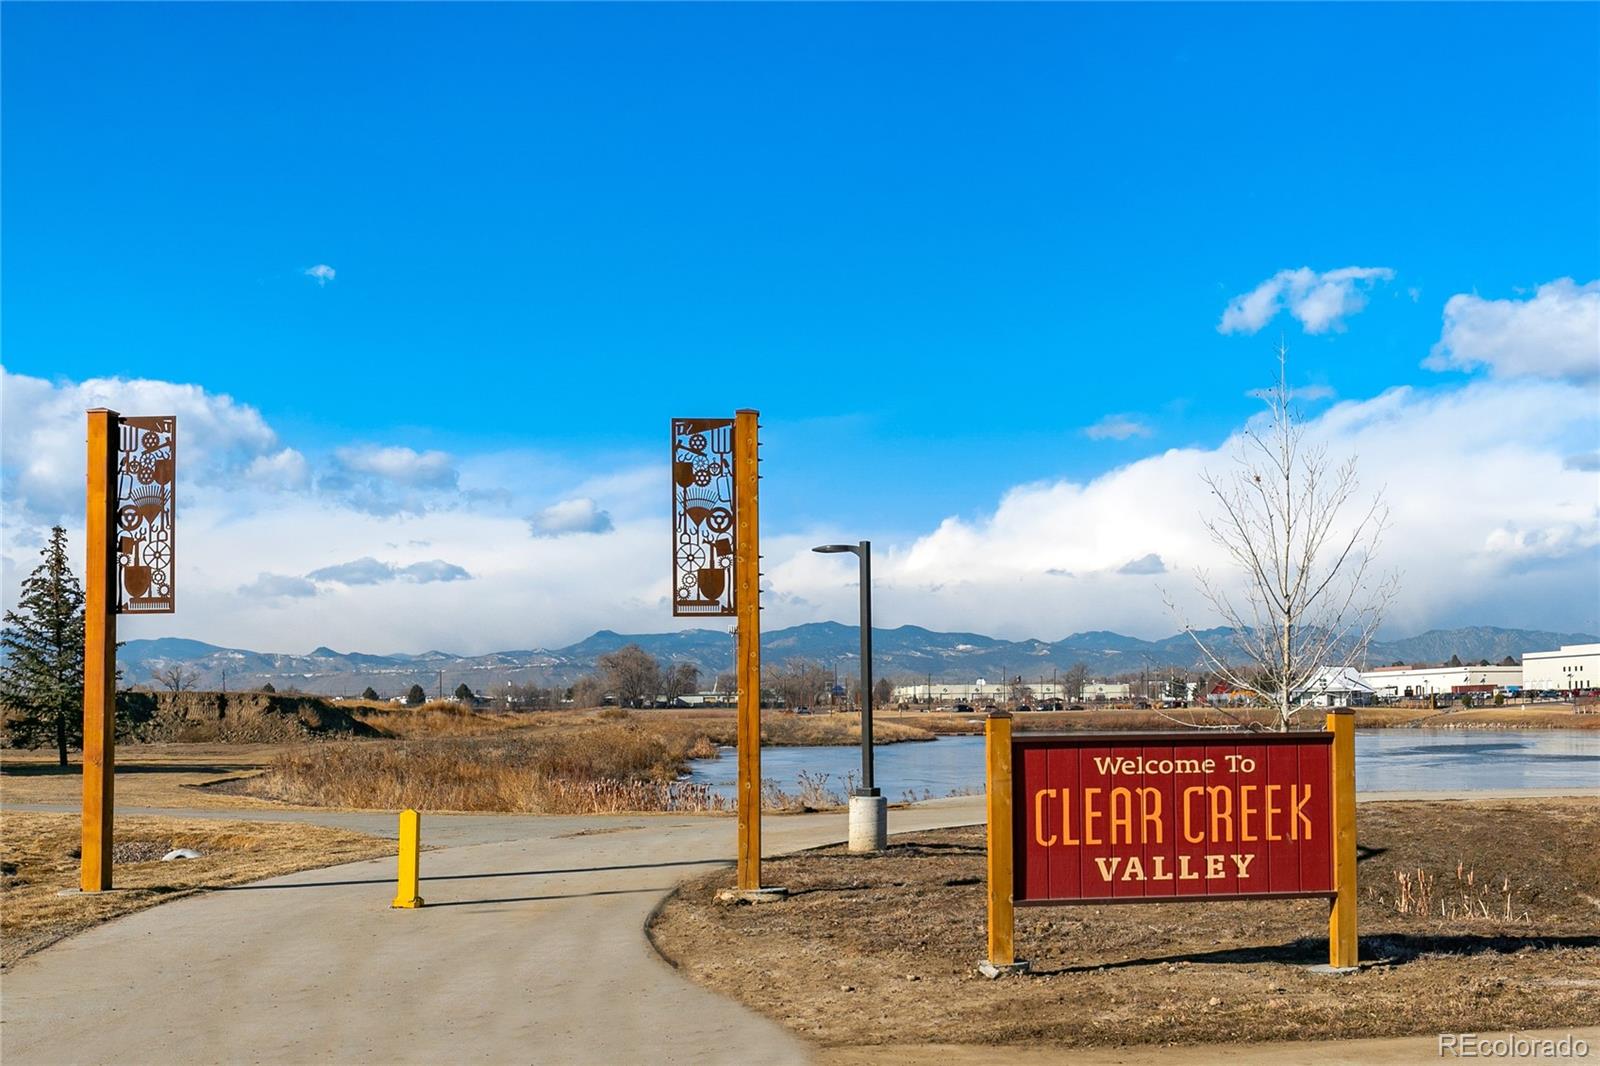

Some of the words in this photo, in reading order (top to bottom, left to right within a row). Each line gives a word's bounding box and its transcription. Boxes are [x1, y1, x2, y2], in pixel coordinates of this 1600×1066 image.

[1094, 756, 1216, 776] Welcome
[1225, 755, 1256, 774] To
[1035, 786, 1163, 847] CLEAR
[1183, 784, 1312, 844] CREEK
[1095, 854, 1255, 882] VALLEY
